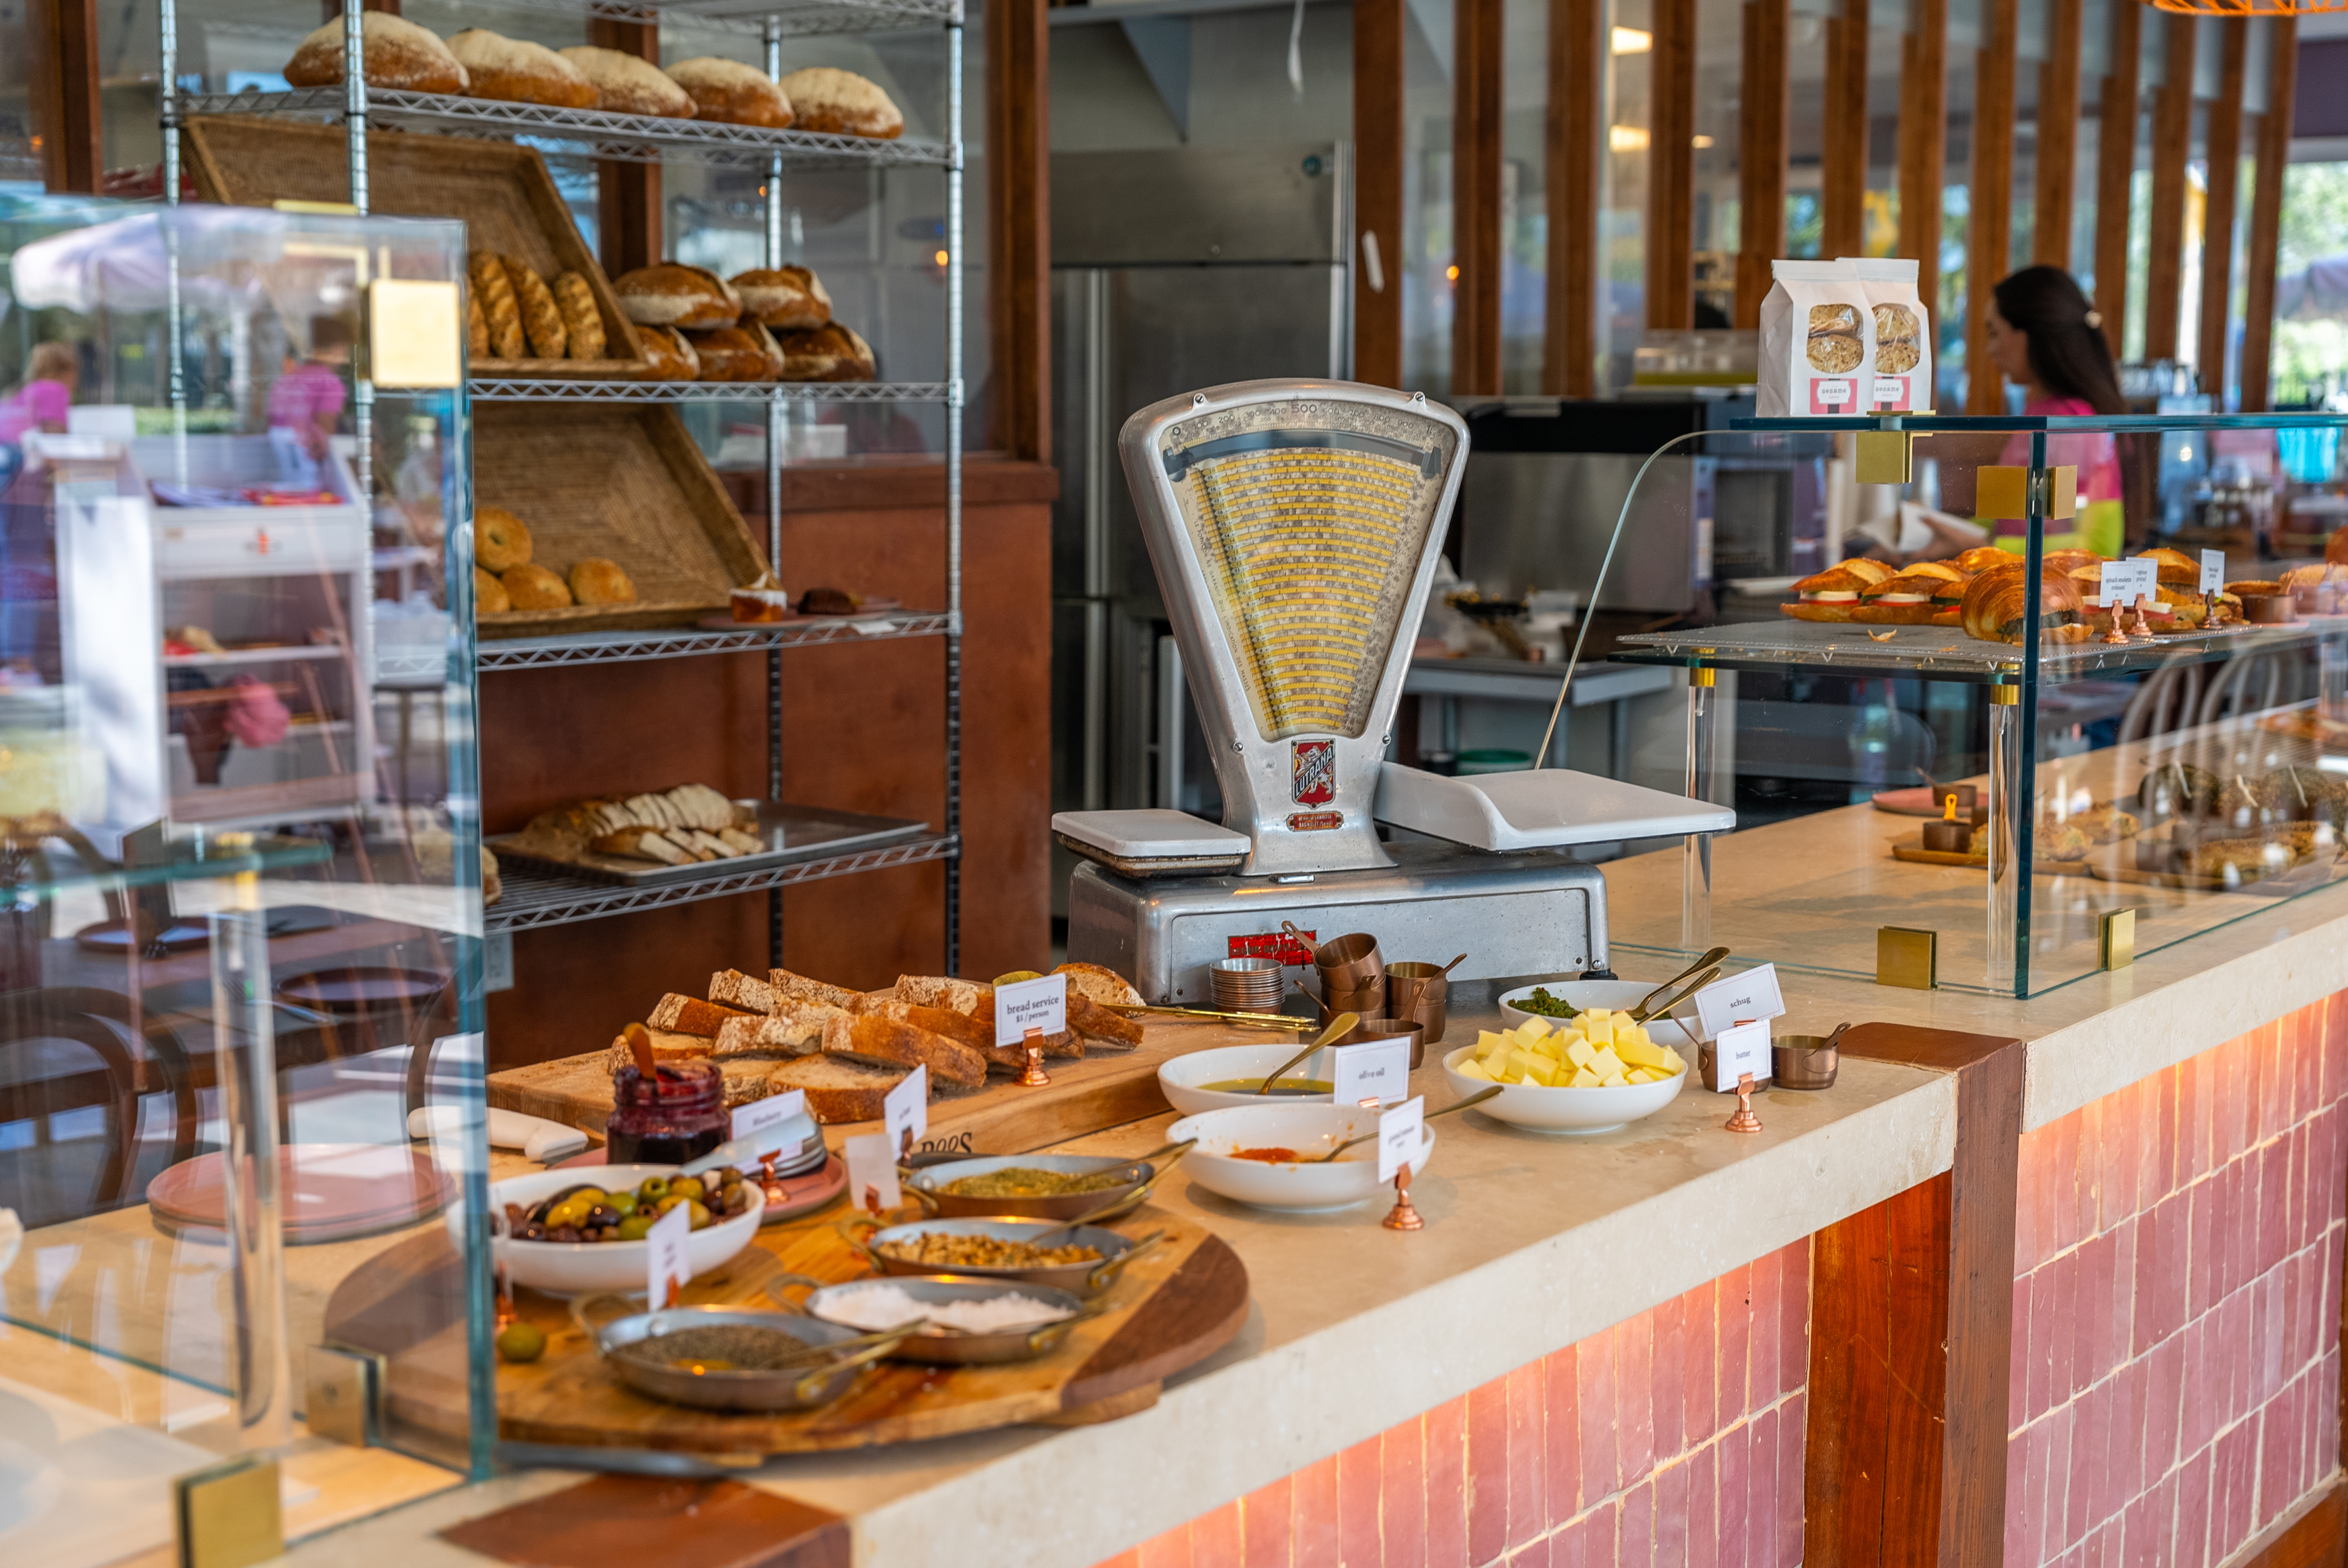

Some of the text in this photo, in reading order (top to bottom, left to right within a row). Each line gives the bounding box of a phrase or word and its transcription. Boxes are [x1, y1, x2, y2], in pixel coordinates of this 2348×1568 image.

[1172, 426, 1181, 436] 0
[1193, 421, 1208, 429] 100
[1219, 415, 1235, 423] 200
[1244, 410, 1261, 418] 300
[1291, 405, 1317, 413] 500
[1350, 410, 1365, 418] 700
[1374, 415, 1390, 423] 800
[1398, 420, 1414, 429] 900
[2106, 576, 2117, 584] spinach
[1209, 570, 1221, 597] GARANTIT
[1223, 616, 1238, 653] L'INDICATION
[1295, 746, 1333, 797] LUTRANA
[1007, 996, 1059, 1014] bread service
[1730, 997, 1751, 1008] schug
[1016, 1014, 1023, 1023] $5
[1029, 1010, 1049, 1022] person
[1736, 1050, 1750, 1060] butter
[1359, 1067, 1384, 1079] olive oil
